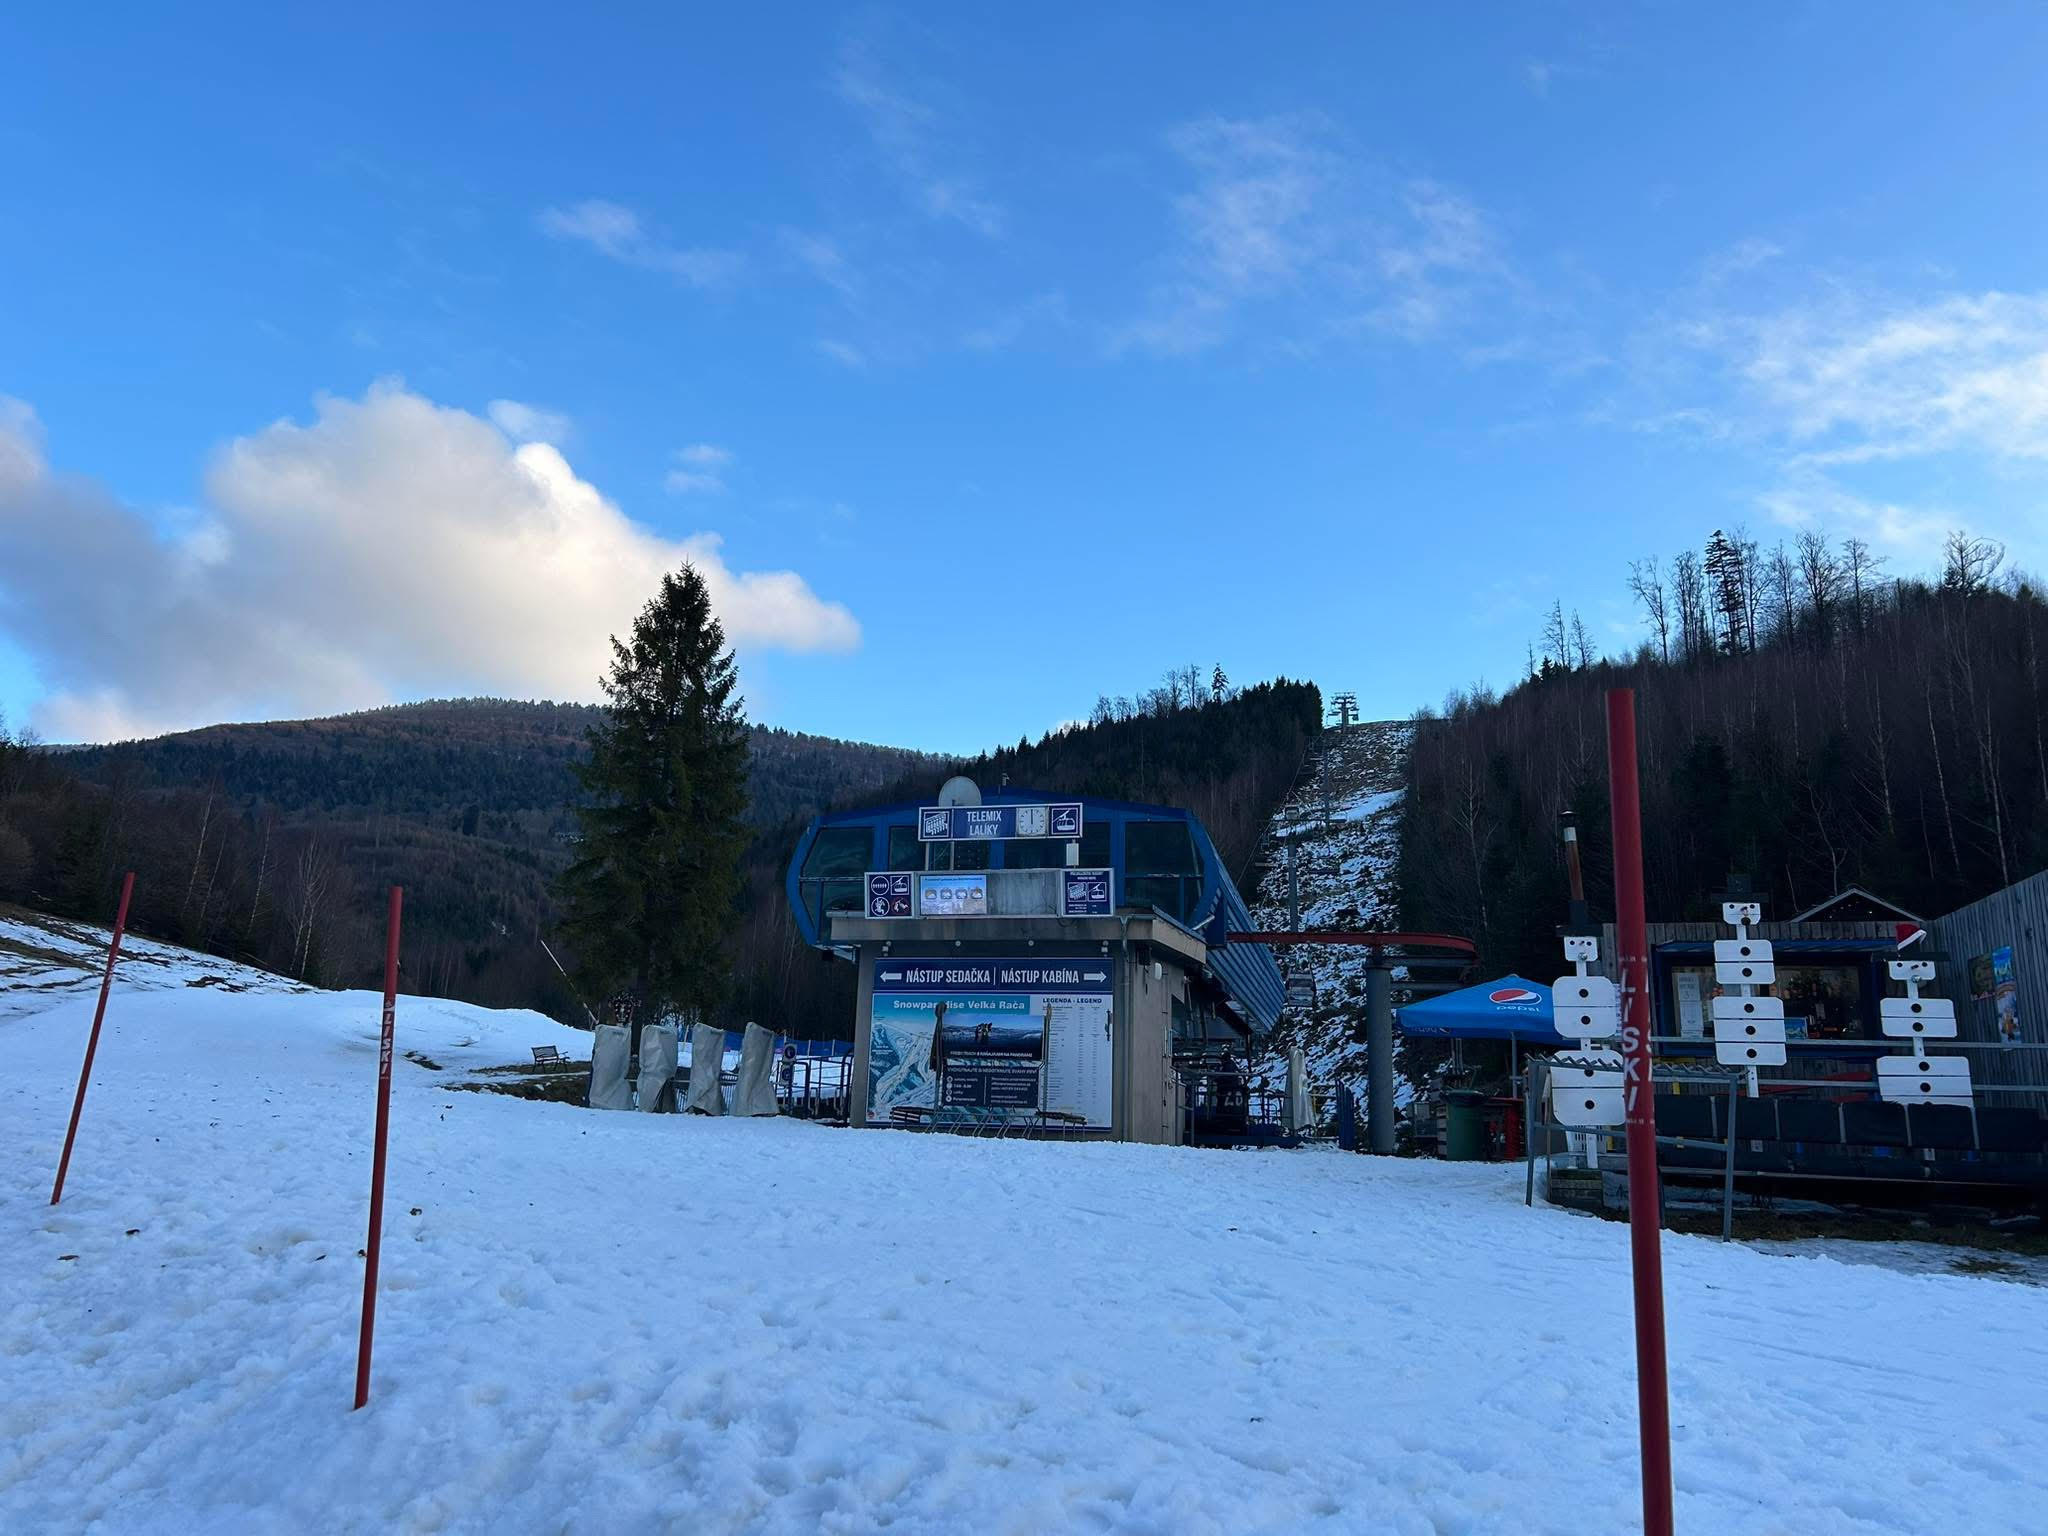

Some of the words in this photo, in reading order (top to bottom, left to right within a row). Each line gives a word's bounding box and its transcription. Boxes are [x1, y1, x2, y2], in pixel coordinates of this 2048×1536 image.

[967, 810, 1002, 822] TELEMIX
[906, 967, 944, 983] NÁSTUP
[946, 967, 991, 983] SEDAČKA
[1001, 967, 1040, 983] NÁSTUP
[1042, 967, 1080, 983] KABÍNA
[893, 1000, 965, 1010] Snowpardise
[999, 1000, 1025, 1010] Rača
